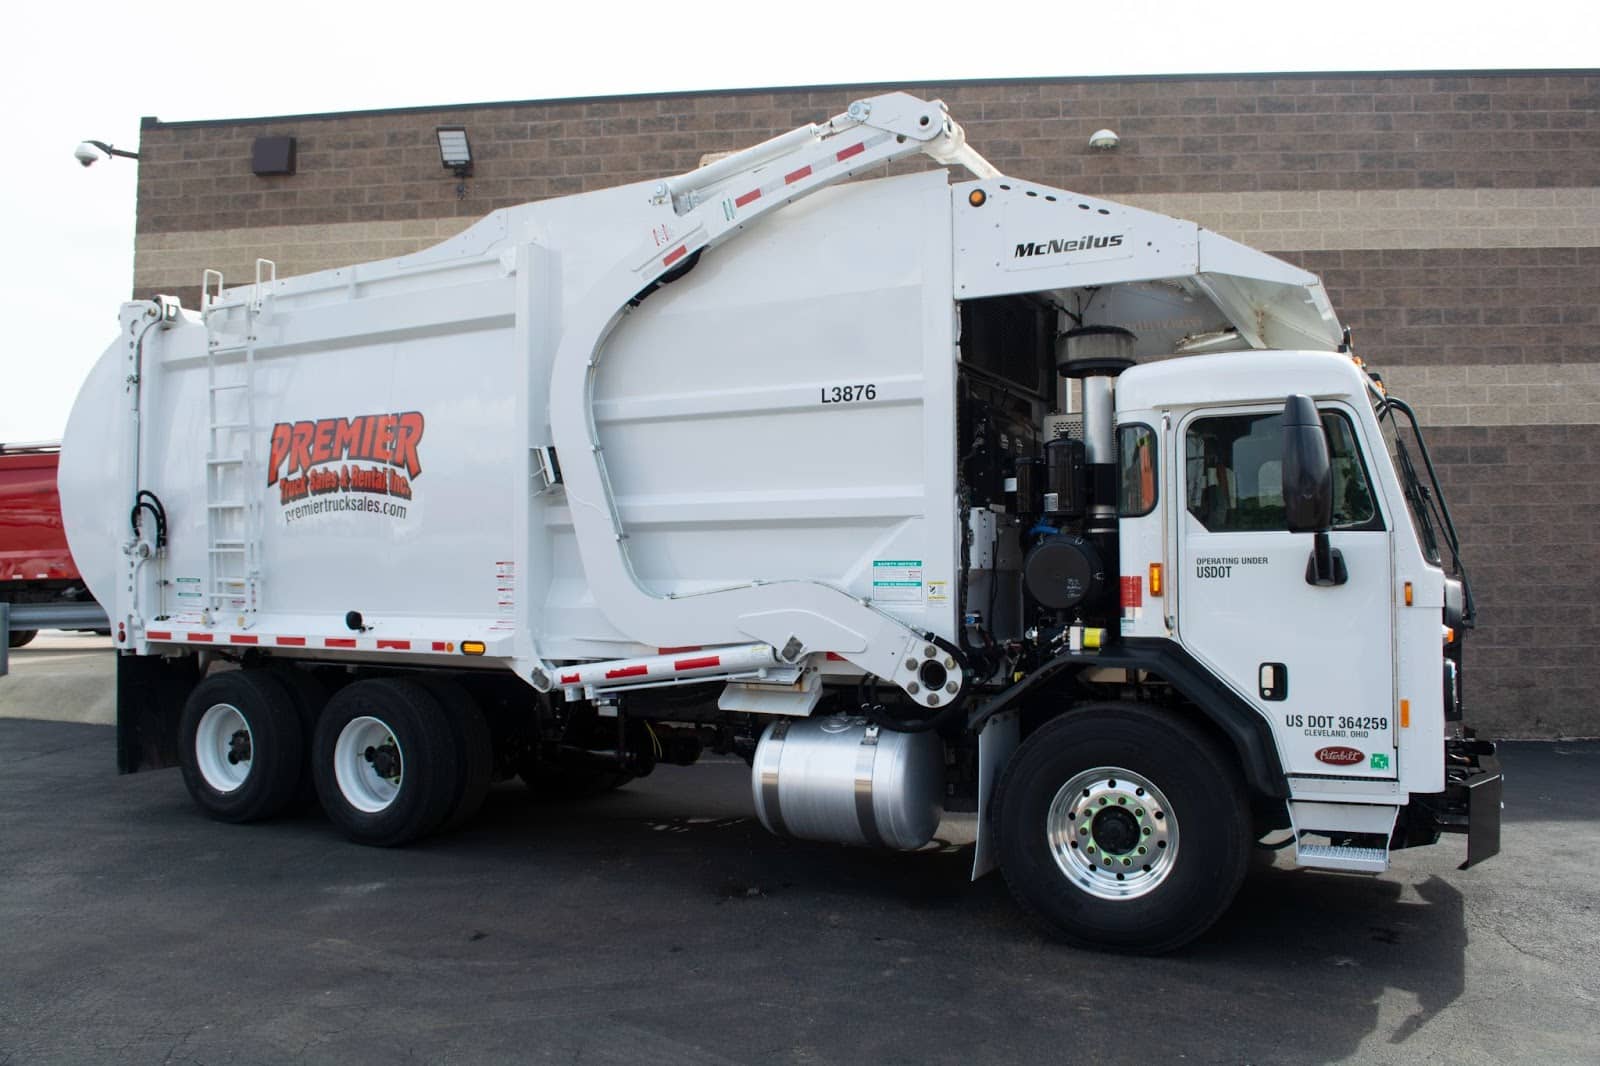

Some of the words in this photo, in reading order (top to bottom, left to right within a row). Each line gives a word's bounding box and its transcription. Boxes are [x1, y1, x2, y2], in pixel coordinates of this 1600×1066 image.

[1014, 234, 1124, 258] McNeilus
[821, 384, 877, 404] L3876
[267, 411, 425, 488] PREMIER
[279, 475, 309, 505] Truck
[308, 467, 340, 496] Sales
[339, 464, 350, 492] &
[351, 464, 388, 495] Rental
[389, 467, 412, 501] Inc.
[285, 496, 407, 524] premiertrucksales.com
[1196, 557, 1239, 565] OPERATING
[1241, 556, 1268, 565] UNDER
[1196, 566, 1232, 578] USDOT
[1286, 715, 1303, 727] US
[1308, 715, 1334, 728] DOT
[1338, 716, 1388, 730] 364259
[1304, 729, 1349, 738] CLEVELAND,
[1350, 730, 1369, 738] OHIO
[1320, 749, 1360, 761] Peterbilt
